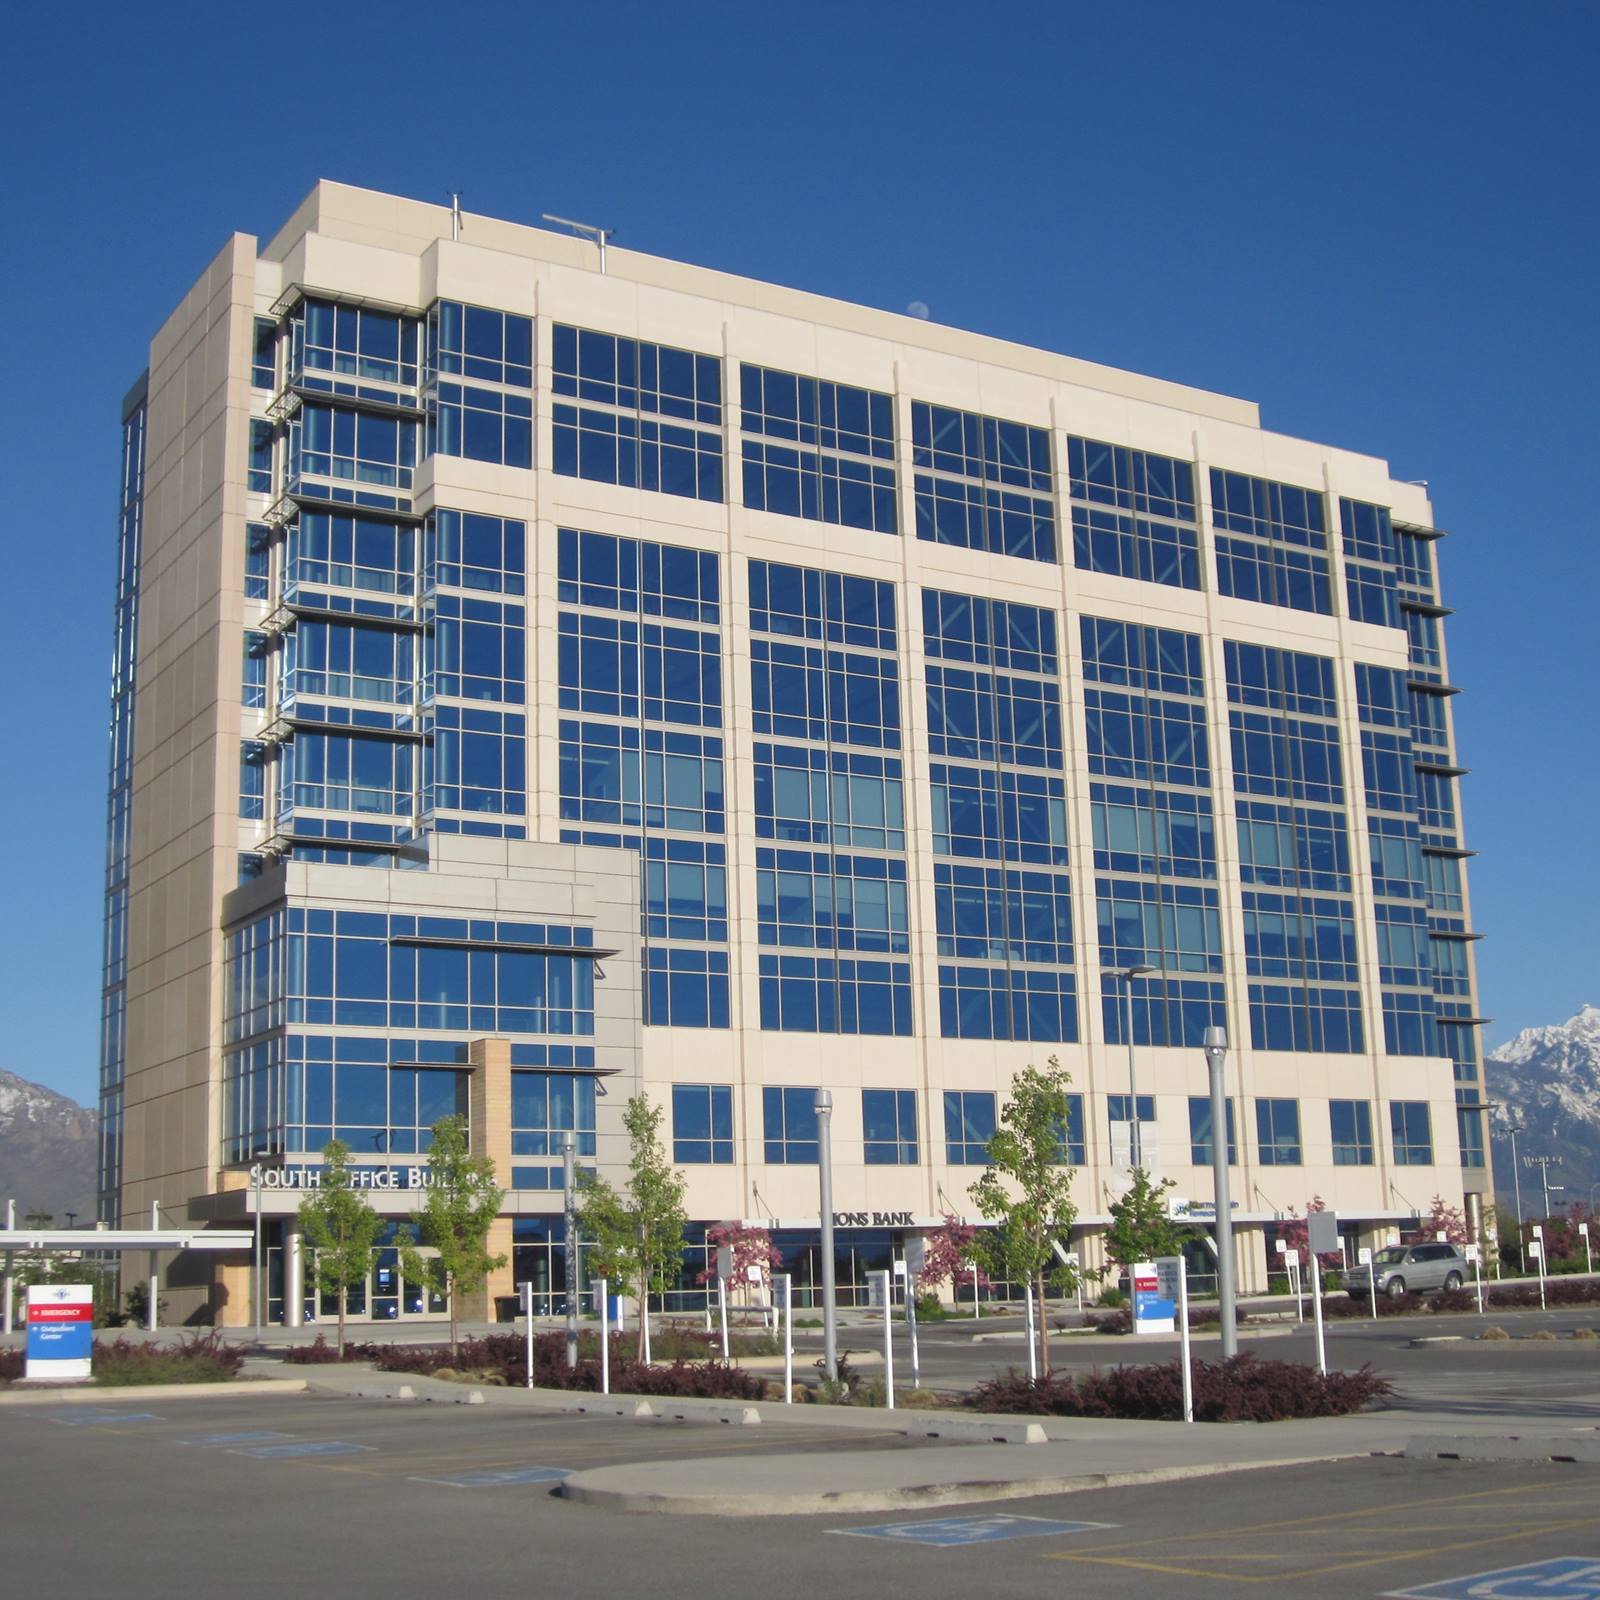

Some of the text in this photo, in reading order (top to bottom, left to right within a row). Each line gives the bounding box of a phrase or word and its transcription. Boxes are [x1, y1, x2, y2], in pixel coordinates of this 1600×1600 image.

[330, 1168, 399, 1188] FFICE
[819, 1211, 915, 1226] IONS BANK
